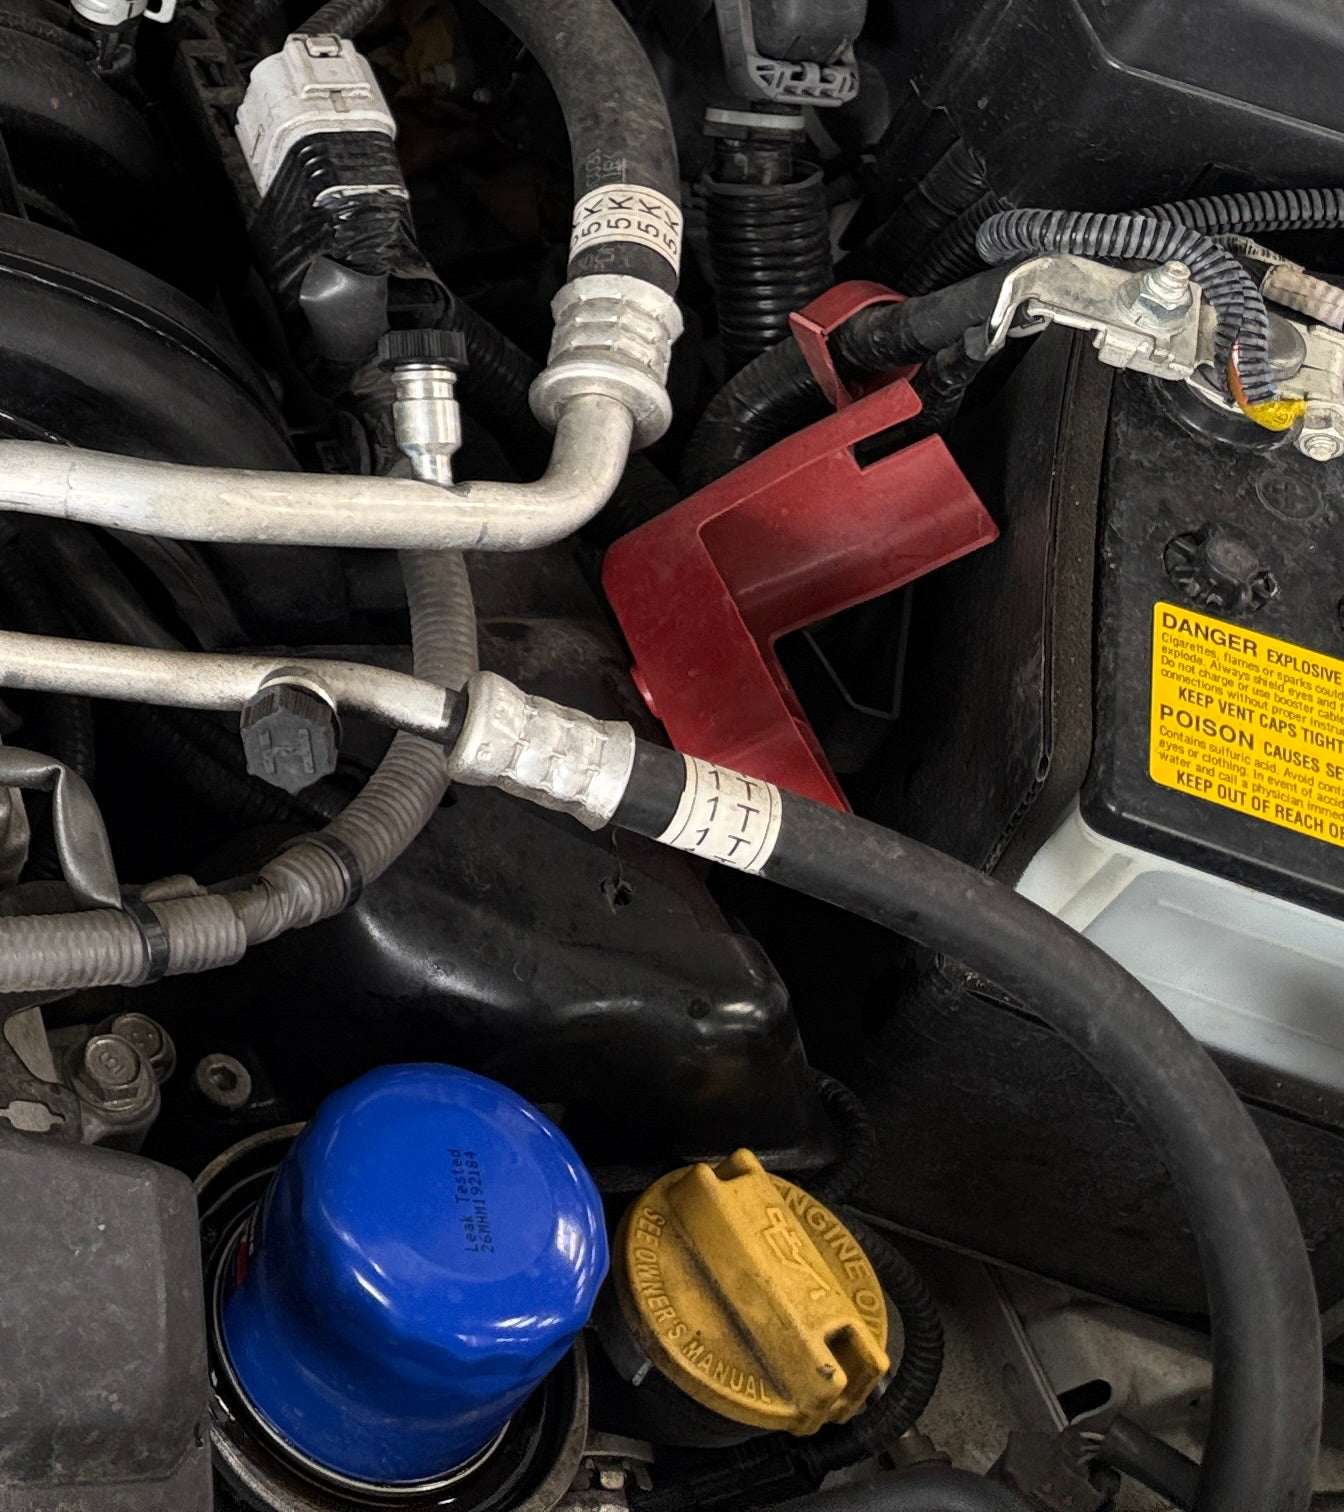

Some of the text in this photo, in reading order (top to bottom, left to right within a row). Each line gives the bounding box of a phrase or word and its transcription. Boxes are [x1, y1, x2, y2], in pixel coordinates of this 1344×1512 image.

[1162, 611, 1341, 685] DANGER EXPLOSIVE
[1224, 652, 1260, 673] flames
[1262, 667, 1274, 677] or
[1277, 672, 1312, 691] sparks
[1161, 654, 1174, 668] Do
[1178, 660, 1194, 674] not
[1199, 668, 1233, 689] charge
[1238, 682, 1248, 692] or
[1252, 687, 1269, 699] use
[1274, 693, 1314, 714] booster
[1161, 667, 1223, 696] connections
[1227, 689, 1267, 711] without
[1272, 704, 1306, 724] proper
[1179, 685, 1213, 710] KEEP
[1218, 699, 1253, 724] VENT
[1259, 713, 1296, 738] CAPS
[1210, 659, 1249, 683] Always
[1254, 673, 1284, 693] shield
[1288, 688, 1312, 704] eyes
[1317, 695, 1336, 710] and
[1159, 724, 1205, 749] Contains
[1209, 742, 1250, 765] sulfuric
[1283, 767, 1314, 787] Avoid
[1159, 737, 1184, 755] eyes
[1187, 748, 1198, 759] or
[1253, 769, 1264, 781] In
[1267, 775, 1297, 793] event
[1301, 785, 1312, 799] of
[1160, 703, 1253, 750] POISON
[1264, 740, 1319, 773] CAUSES
[1159, 749, 1190, 768] water
[1195, 763, 1214, 777] and
[1218, 770, 1236, 784] call
[1242, 779, 1247, 788] a
[1252, 782, 1303, 808] physician
[1177, 769, 1212, 794] KEEP
[1217, 783, 1246, 807] OUT
[1251, 795, 1270, 814] OF
[1275, 803, 1323, 834] REACH
[447, 1148, 480, 1252] Leak Tested
[775, 1181, 870, 1280] NGINE
[635, 1206, 773, 1406] SEE OWNER'S MANUAL
